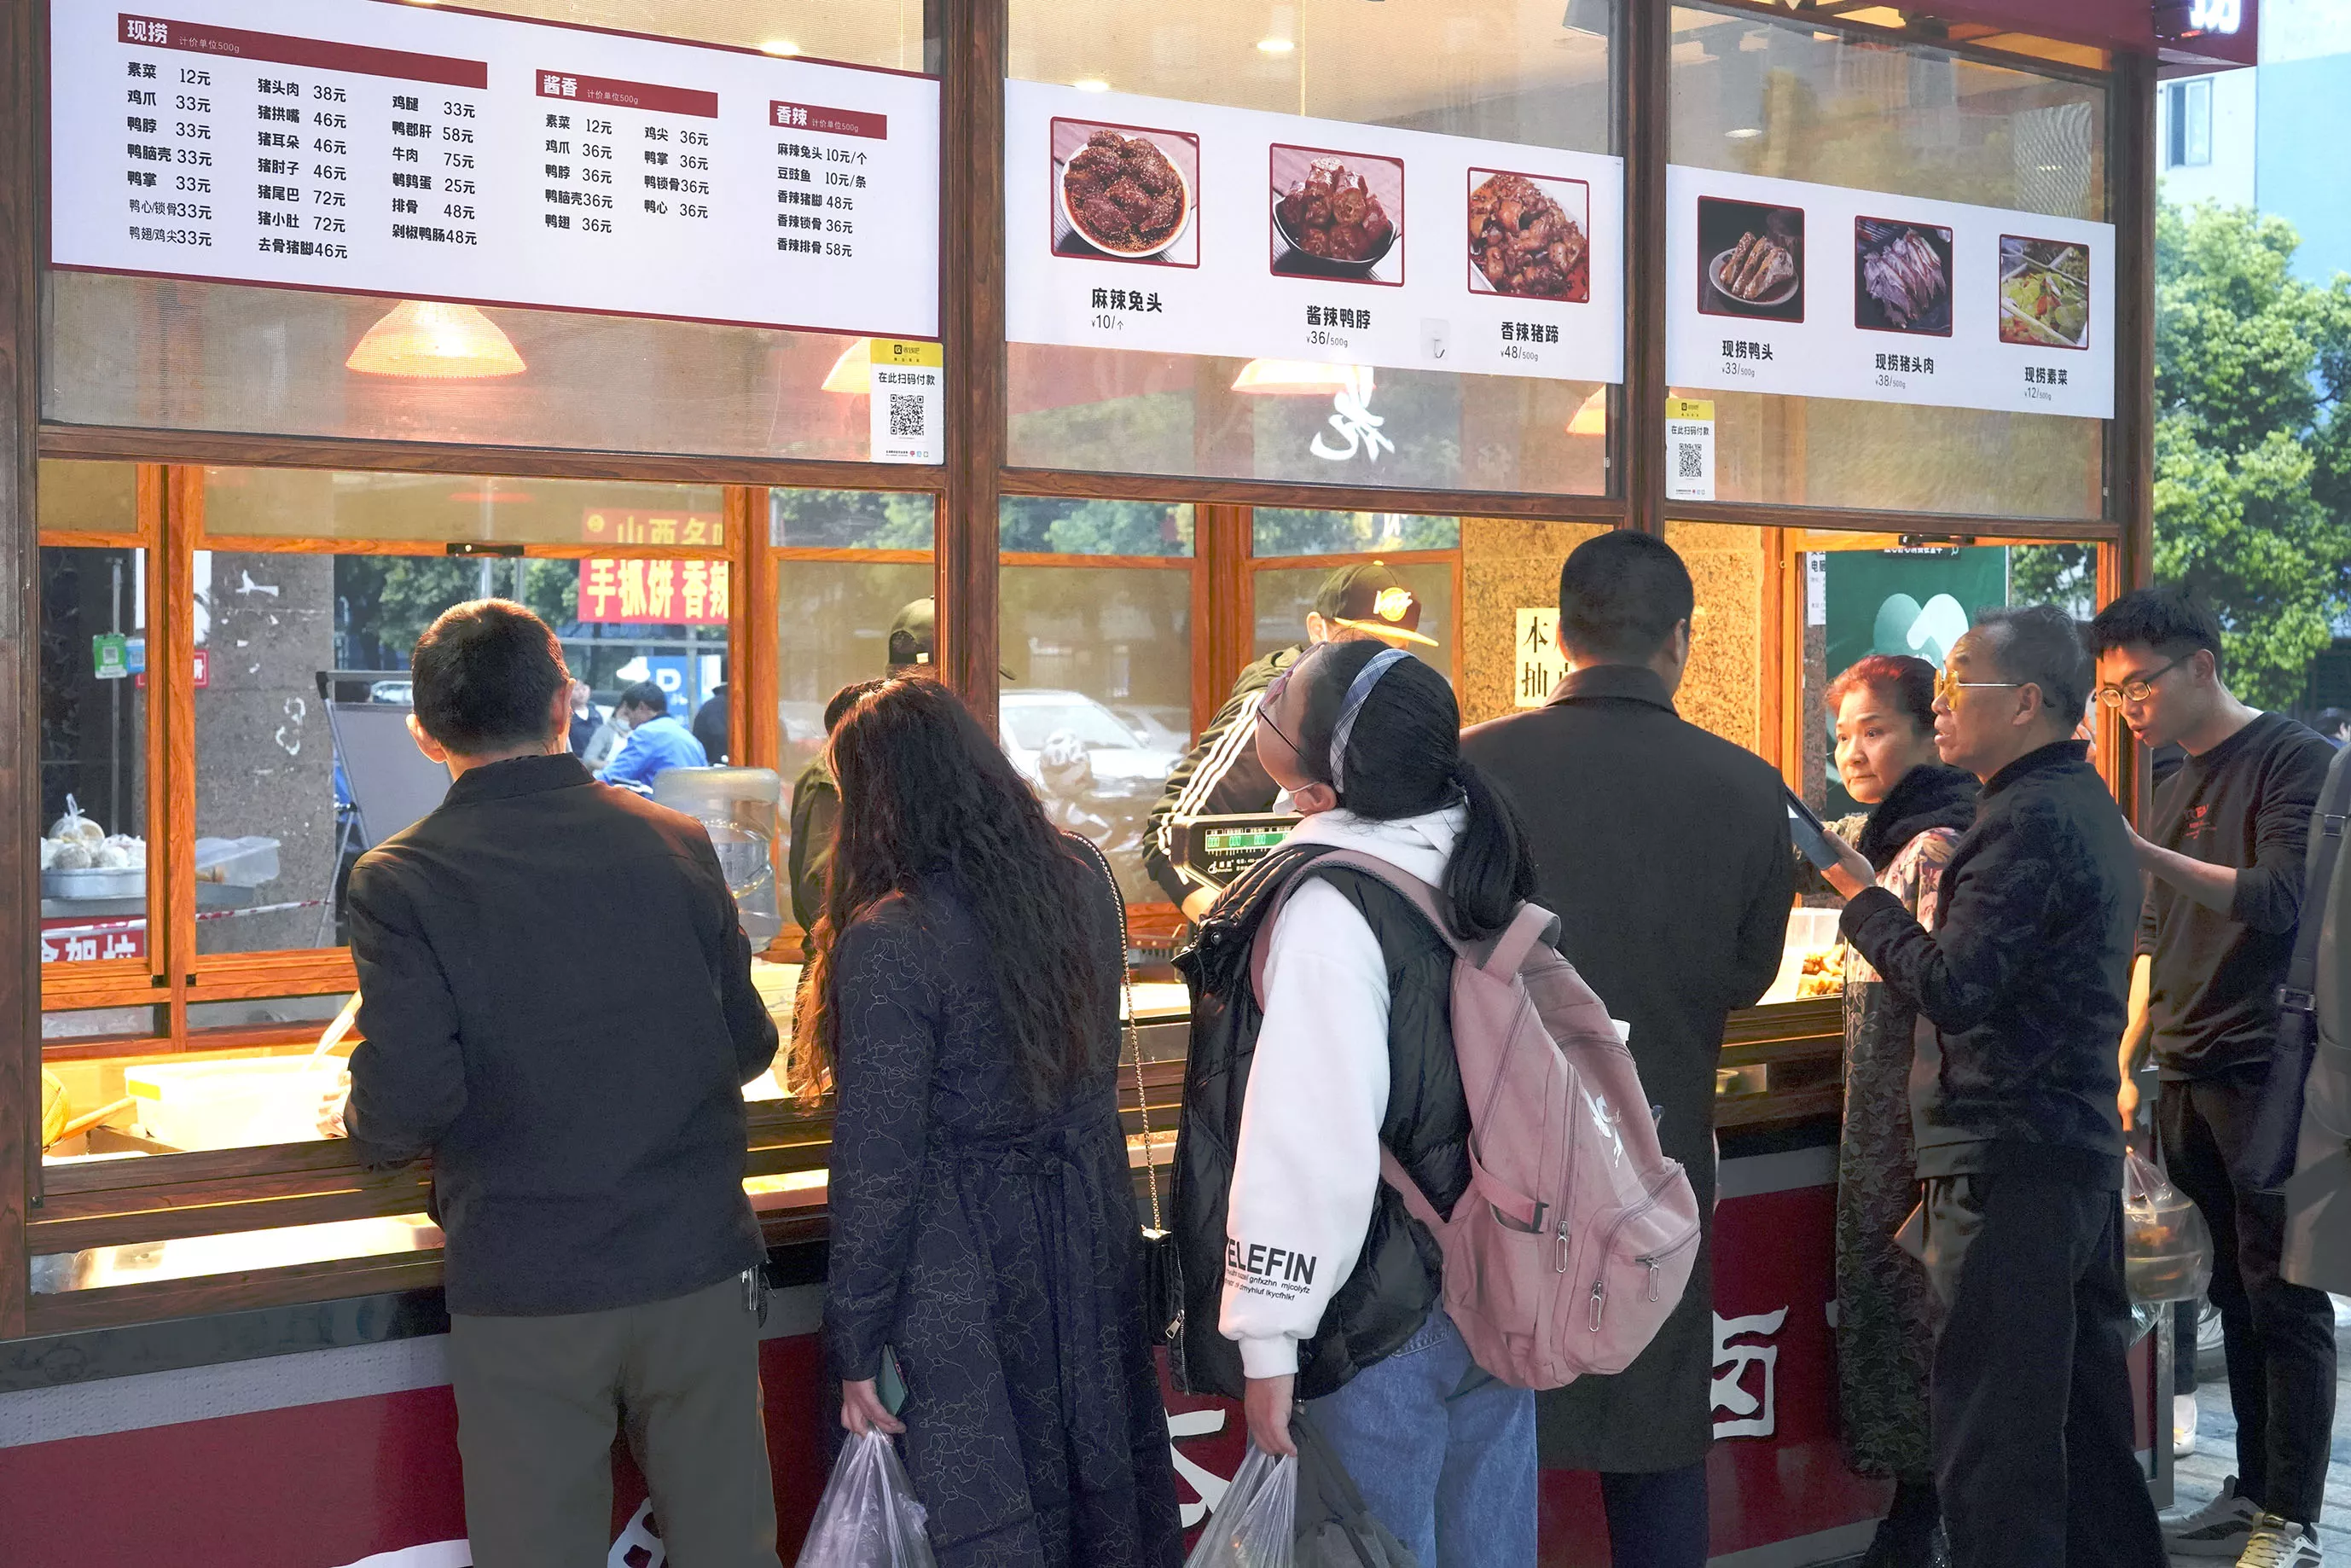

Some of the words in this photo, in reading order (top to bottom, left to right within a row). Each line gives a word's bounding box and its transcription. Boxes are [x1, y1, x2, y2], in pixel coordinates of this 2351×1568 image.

[127, 20, 168, 44] 现捞
[179, 36, 240, 54] 计价单位500g
[127, 61, 157, 79] 素菜
[180, 67, 212, 86] 12元
[127, 89, 157, 107] 鸡爪
[175, 95, 212, 113] 33元
[258, 78, 299, 97] 猪头肉
[313, 84, 346, 103] 38元
[543, 74, 578, 97] 酱香
[587, 89, 639, 105] 计价单位500g
[258, 104, 300, 124] 猪拱嘴
[313, 112, 347, 129] 46元
[392, 95, 419, 112] 鸡腿
[444, 101, 476, 119] 33元
[126, 116, 157, 134] 鸭脖
[176, 121, 212, 140] 33元
[545, 113, 571, 130] 素菜
[586, 119, 612, 135] 12元
[776, 105, 808, 126] 香辣
[812, 119, 859, 133] 计价单位500g
[258, 131, 299, 149] 猪耳朵
[313, 137, 347, 155] 46元
[392, 120, 432, 139] 鸭郡肝
[443, 126, 474, 144] 58元
[644, 125, 669, 142] 鸡尖
[680, 130, 709, 147] 36元
[127, 143, 172, 163] 鸭脑壳
[177, 148, 212, 167] 33元
[392, 146, 418, 163] 牛肉
[444, 152, 475, 169] 75元
[545, 139, 571, 154] 鸡爪
[582, 142, 612, 160] 36元
[644, 150, 669, 166] 鸭掌
[679, 154, 709, 171] 36元
[777, 142, 823, 160] 麻辣兔头
[827, 148, 868, 166] 10元/个
[258, 157, 299, 176] 猪肘子
[313, 164, 347, 181] 46元
[545, 164, 571, 180] 鸭脖
[582, 167, 612, 184] 36元
[777, 166, 811, 183] 豆豉鱼
[825, 171, 867, 189] 10元/条
[127, 170, 157, 188] 鸭掌
[176, 175, 212, 194] 33元
[444, 177, 476, 195] 25元
[258, 183, 300, 202] 猪尾巴
[313, 189, 346, 207] 72元
[777, 189, 823, 207] 香辣猪脚
[826, 195, 854, 211] 48元
[392, 197, 419, 214] 排骨
[443, 203, 475, 220] 48元
[644, 199, 668, 215] 鸭心
[679, 203, 709, 219] 36元
[258, 210, 300, 229] 猪小肚
[313, 216, 346, 233] 72元
[544, 213, 571, 229] 鸭翅
[582, 218, 612, 234] 36元
[777, 213, 822, 231] 香辣锁骨
[826, 218, 853, 235] 36元
[776, 237, 822, 255] 香辣排骨
[826, 242, 852, 258] 58元
[1091, 287, 1163, 313] 麻辣兔头
[1306, 305, 1371, 330] 酱辣鸭脖
[1501, 321, 1559, 345] 香辣猪蹄
[1721, 340, 1773, 361] 现捞鸭头
[1875, 353, 1934, 375] 现捞猪头肉
[878, 372, 936, 386] 在此扫码付款
[2024, 366, 2068, 386] 现捞素菜
[1671, 425, 1710, 436] 在此扫码付款
